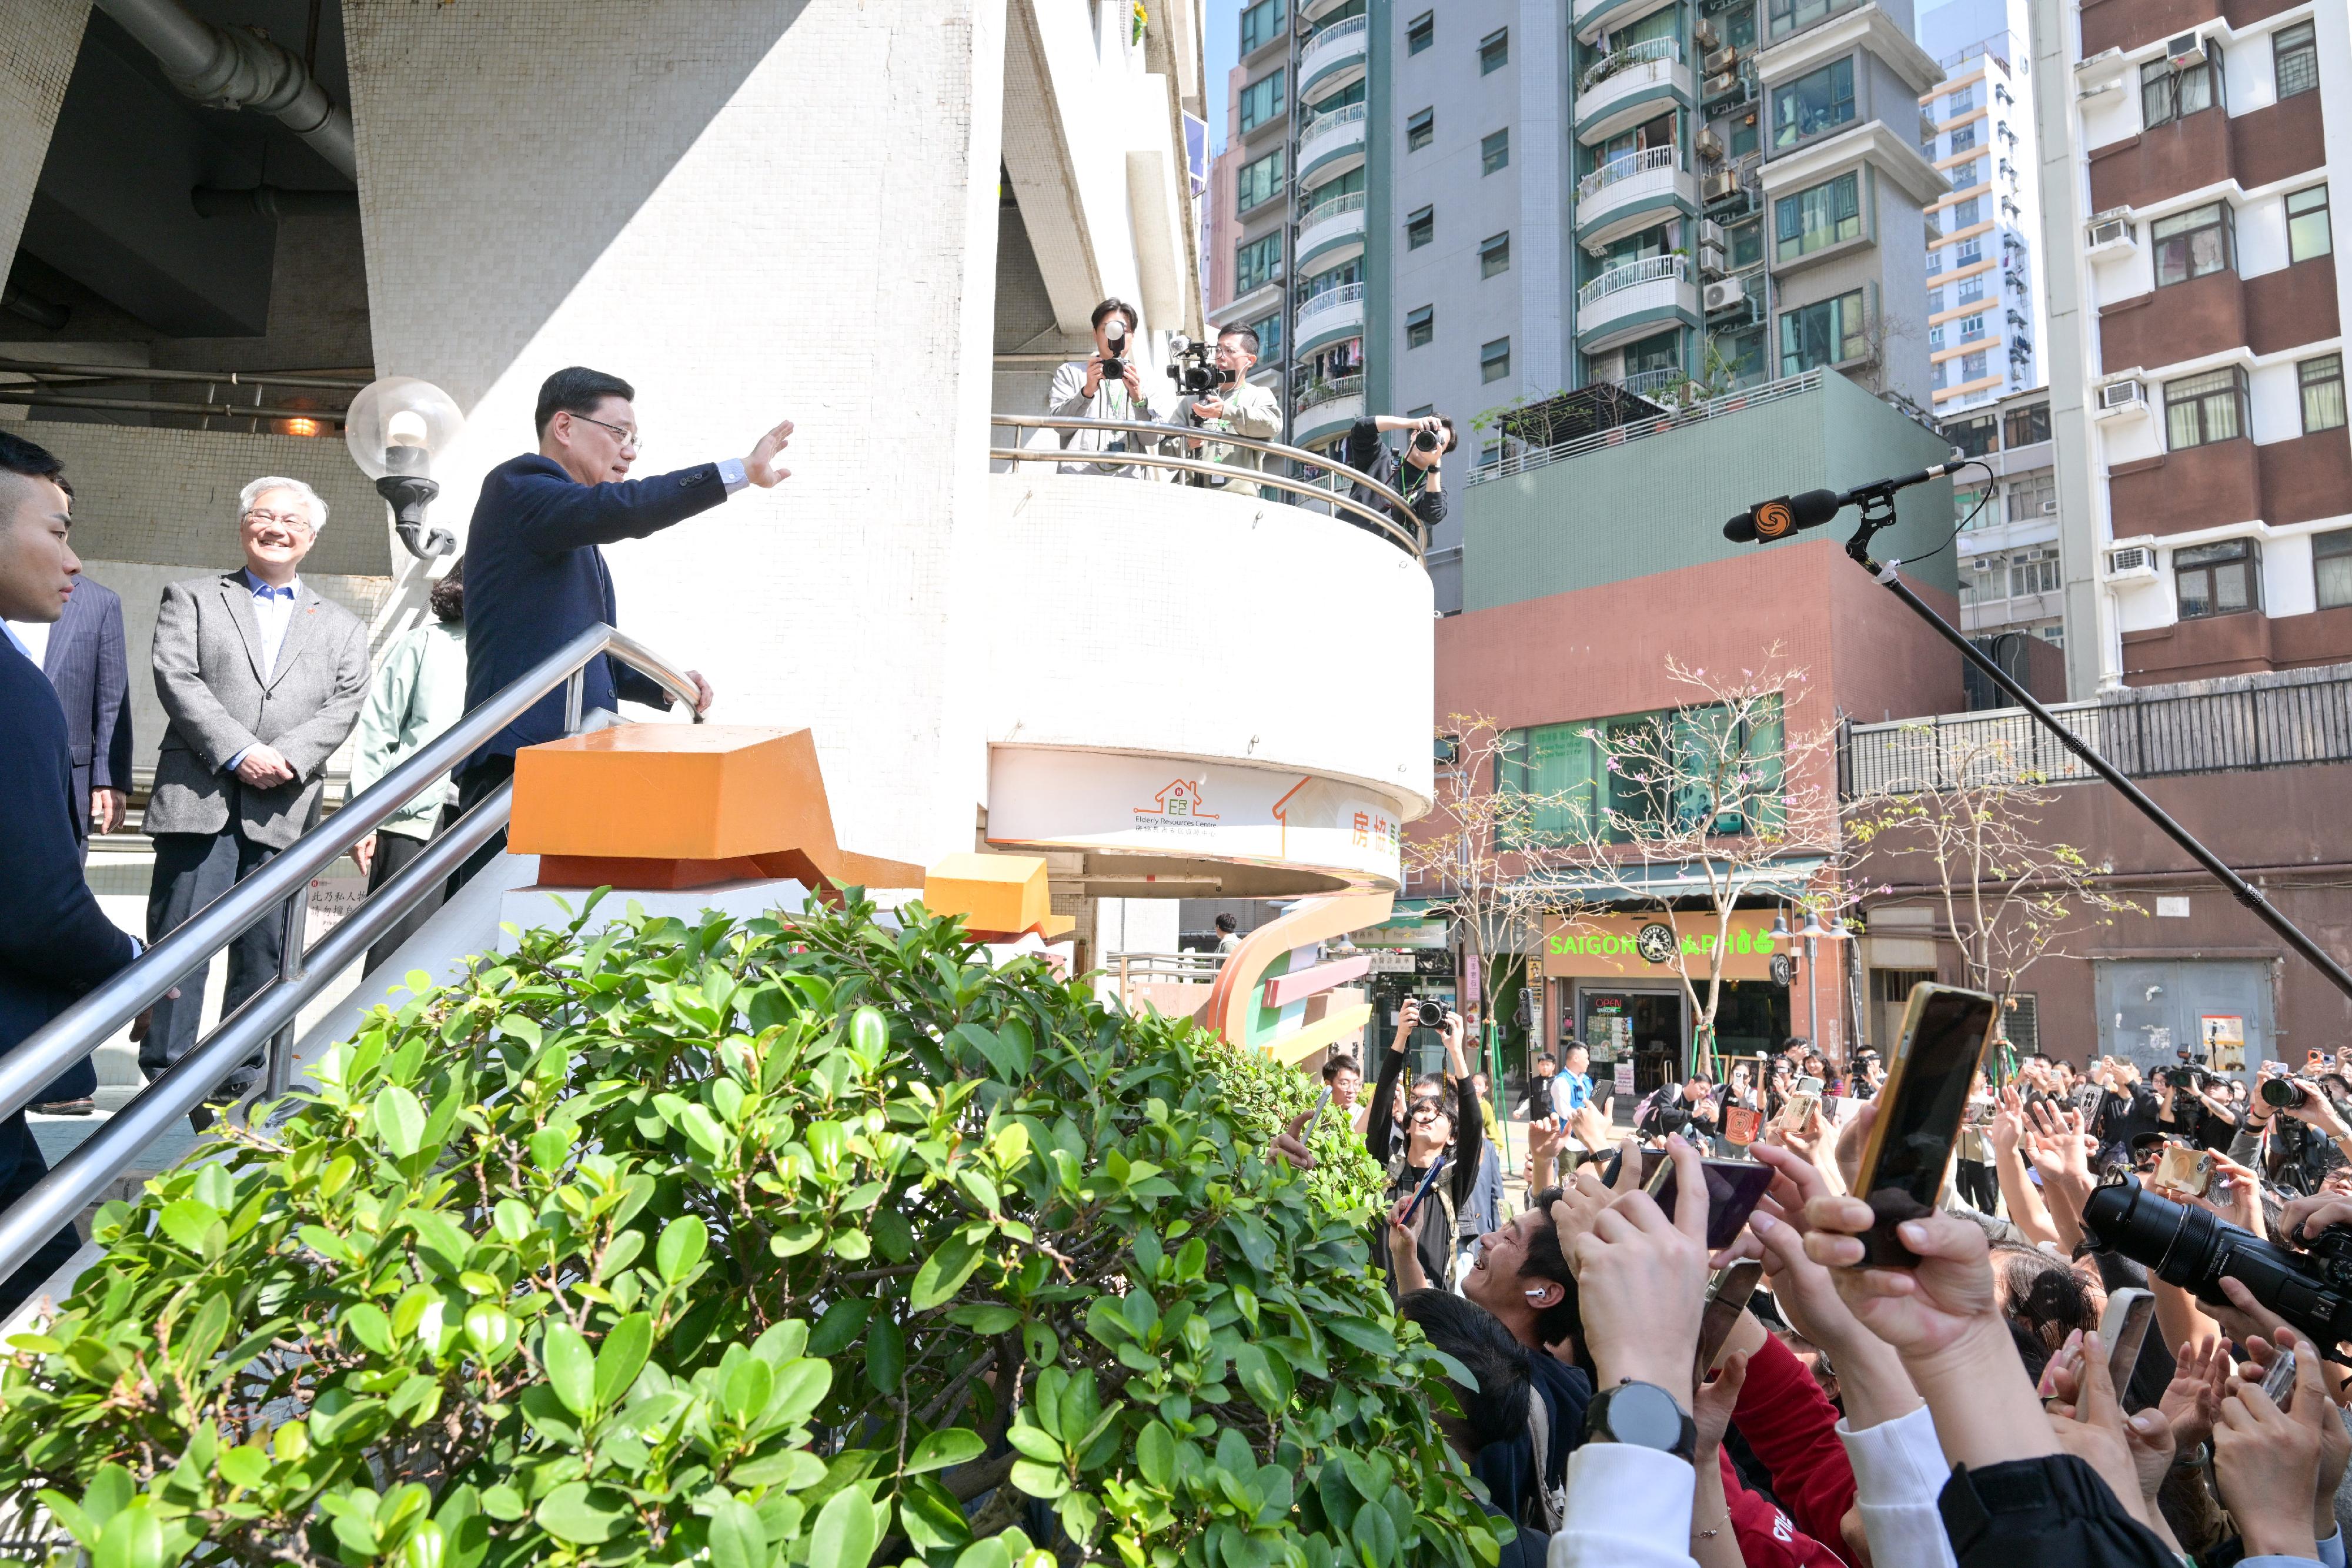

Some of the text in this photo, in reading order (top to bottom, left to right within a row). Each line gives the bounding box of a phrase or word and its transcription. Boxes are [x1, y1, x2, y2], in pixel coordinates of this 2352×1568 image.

[1135, 816, 1159, 824] Elderly
[1161, 818, 1194, 827] Resources
[1549, 935, 1636, 954] SAIGON
[1595, 998, 1621, 1007] OPEN
[2218, 1253, 2229, 1275] Nikon
